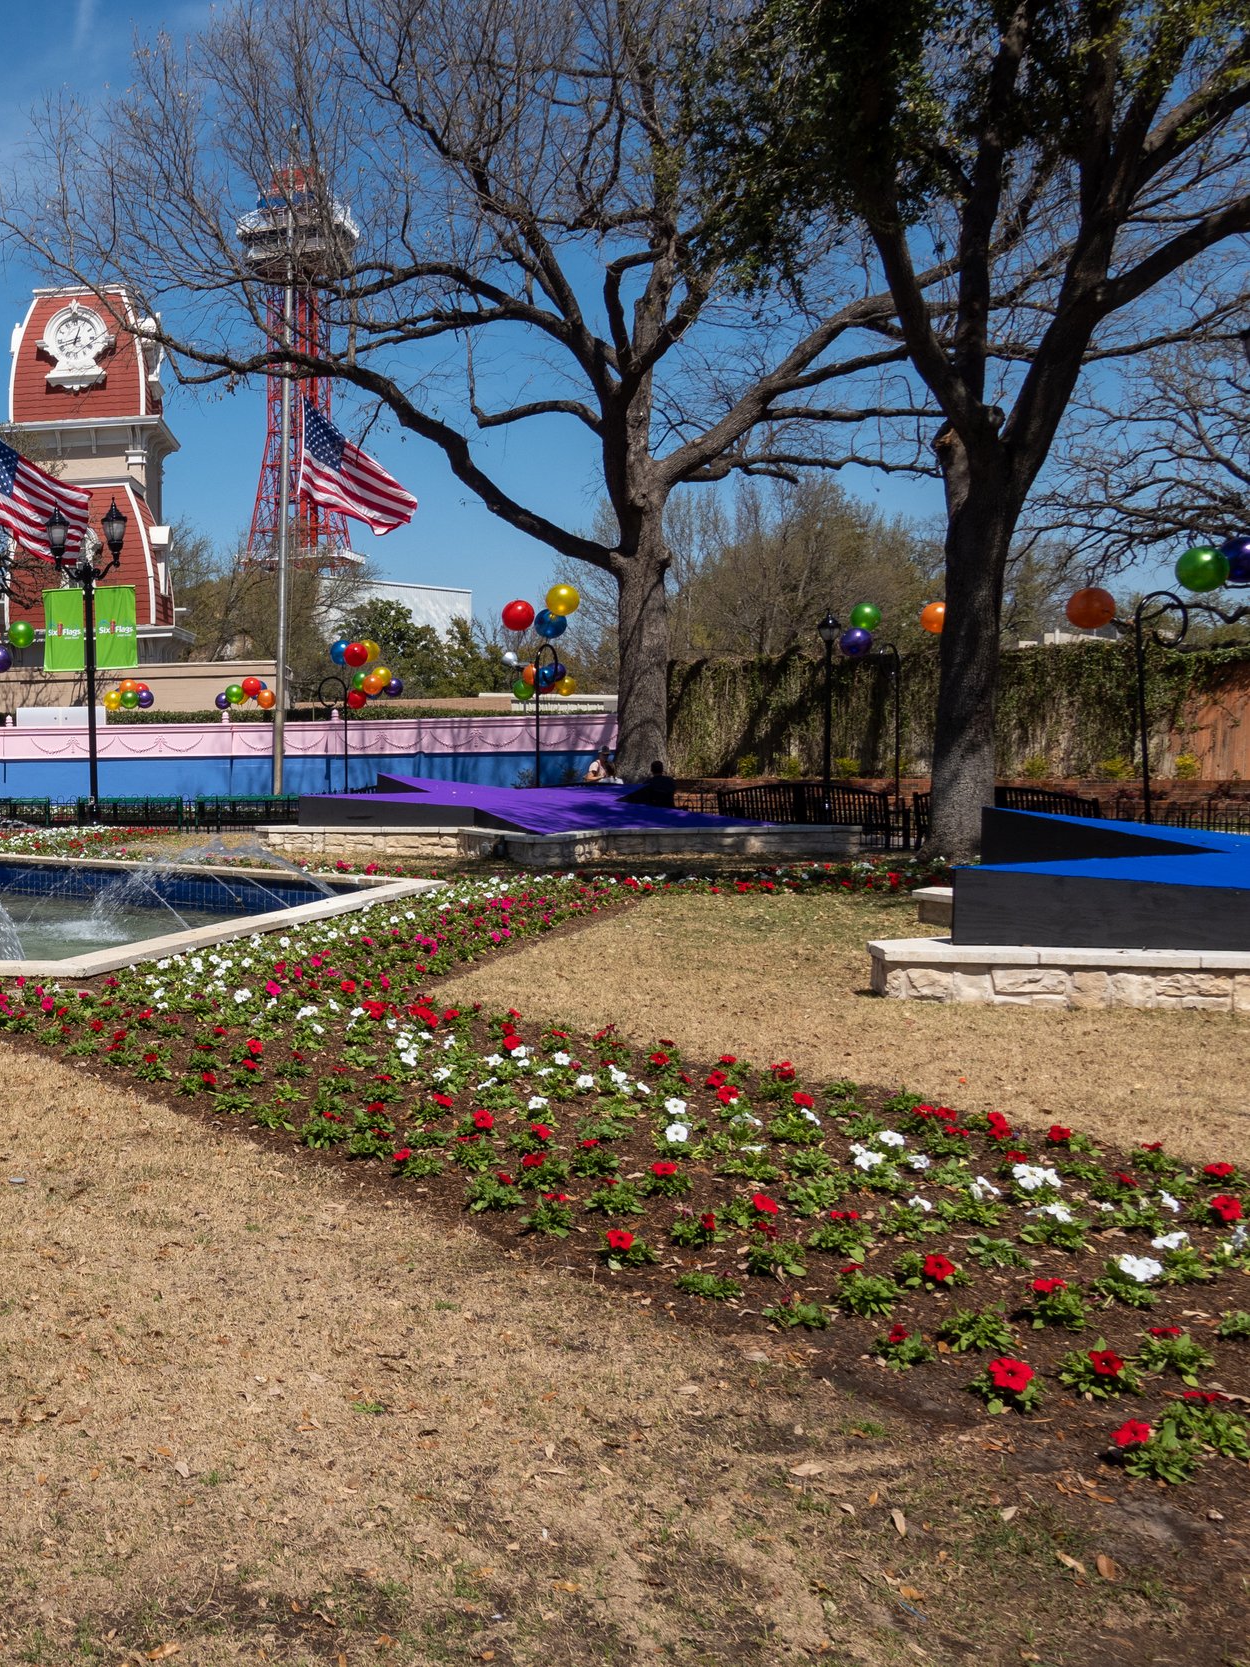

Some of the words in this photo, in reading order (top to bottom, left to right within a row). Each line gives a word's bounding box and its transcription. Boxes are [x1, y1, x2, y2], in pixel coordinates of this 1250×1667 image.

[48, 629, 58, 637] Six
[62, 629, 81, 637] Flags
[115, 626, 133, 634] Flags
